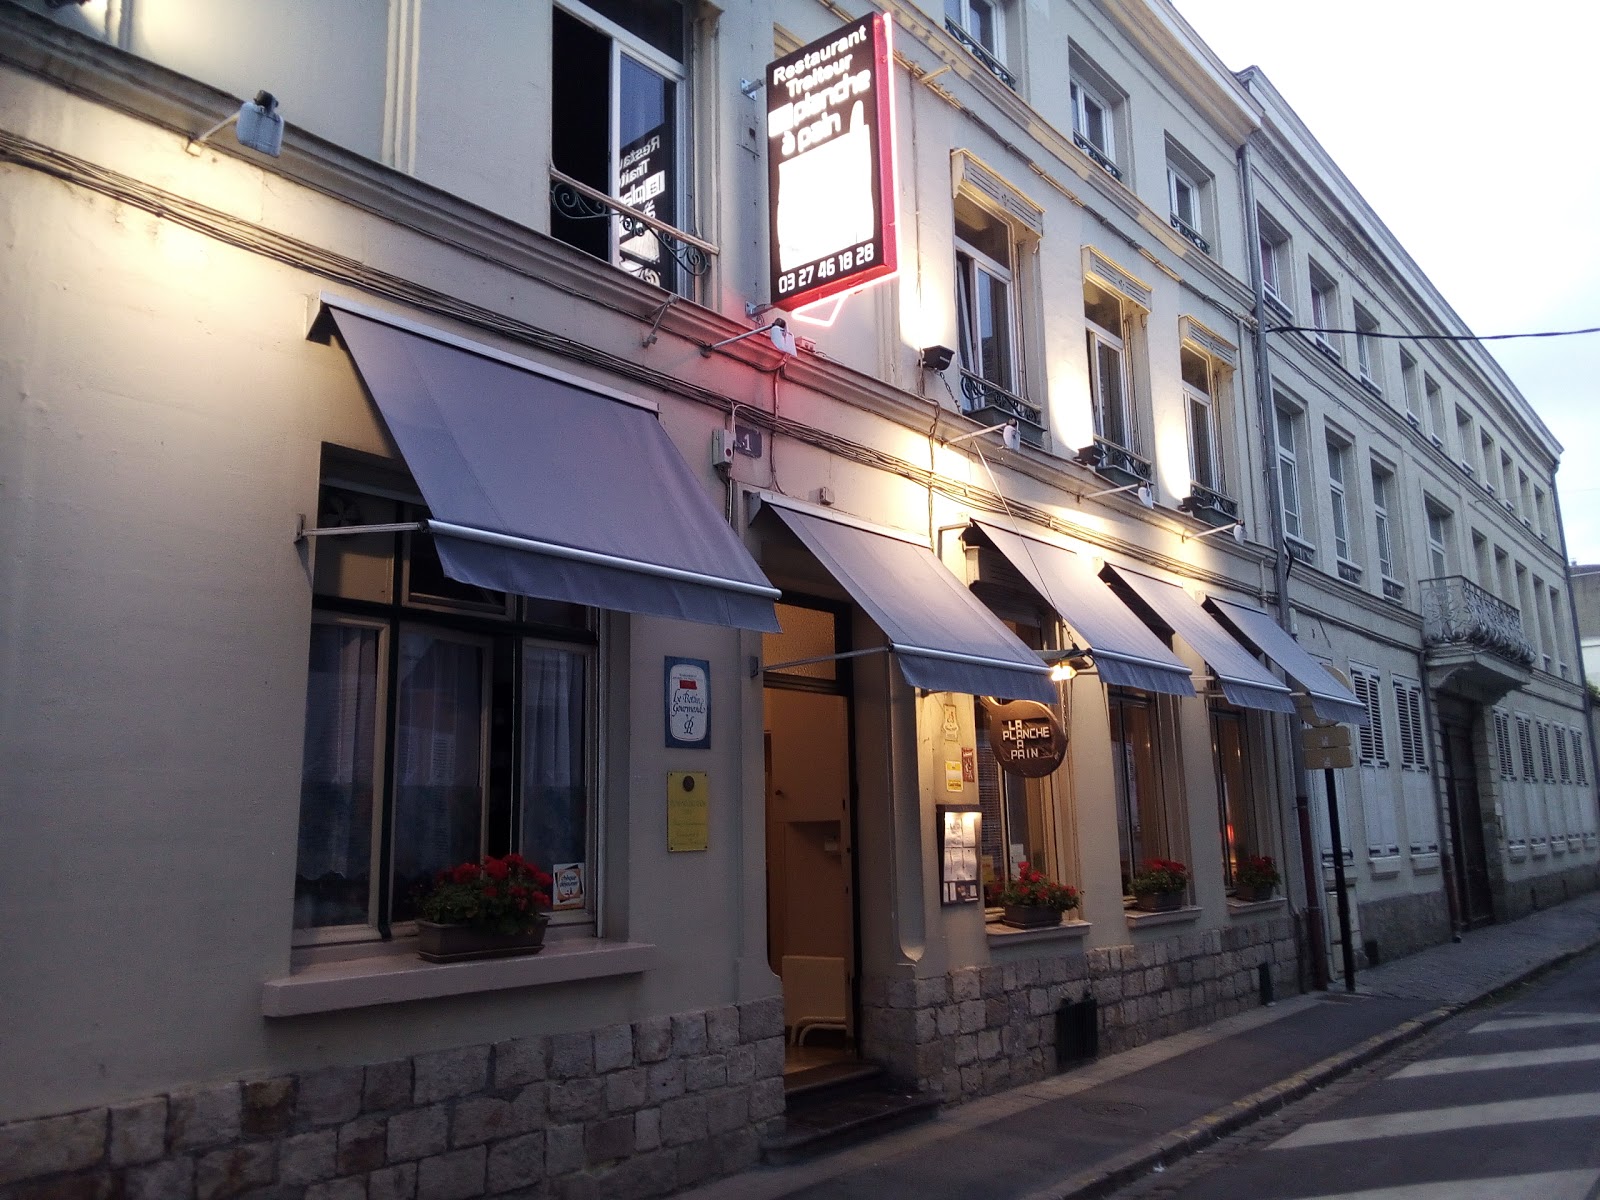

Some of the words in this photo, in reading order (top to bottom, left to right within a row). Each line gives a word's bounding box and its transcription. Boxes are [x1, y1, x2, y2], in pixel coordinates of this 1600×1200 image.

[773, 24, 867, 85] Restaurant
[786, 54, 853, 98] Traiteur
[793, 69, 871, 123] planche
[797, 111, 841, 153] pain
[778, 273, 796, 294] 03
[798, 266, 814, 288] 27
[817, 258, 836, 278] 46
[838, 251, 853, 271] 18
[856, 243, 874, 265] 28
[1003, 727, 1050, 741] PLANCHE
[1008, 720, 1022, 731] LA
[1010, 748, 1038, 760] PAIN
